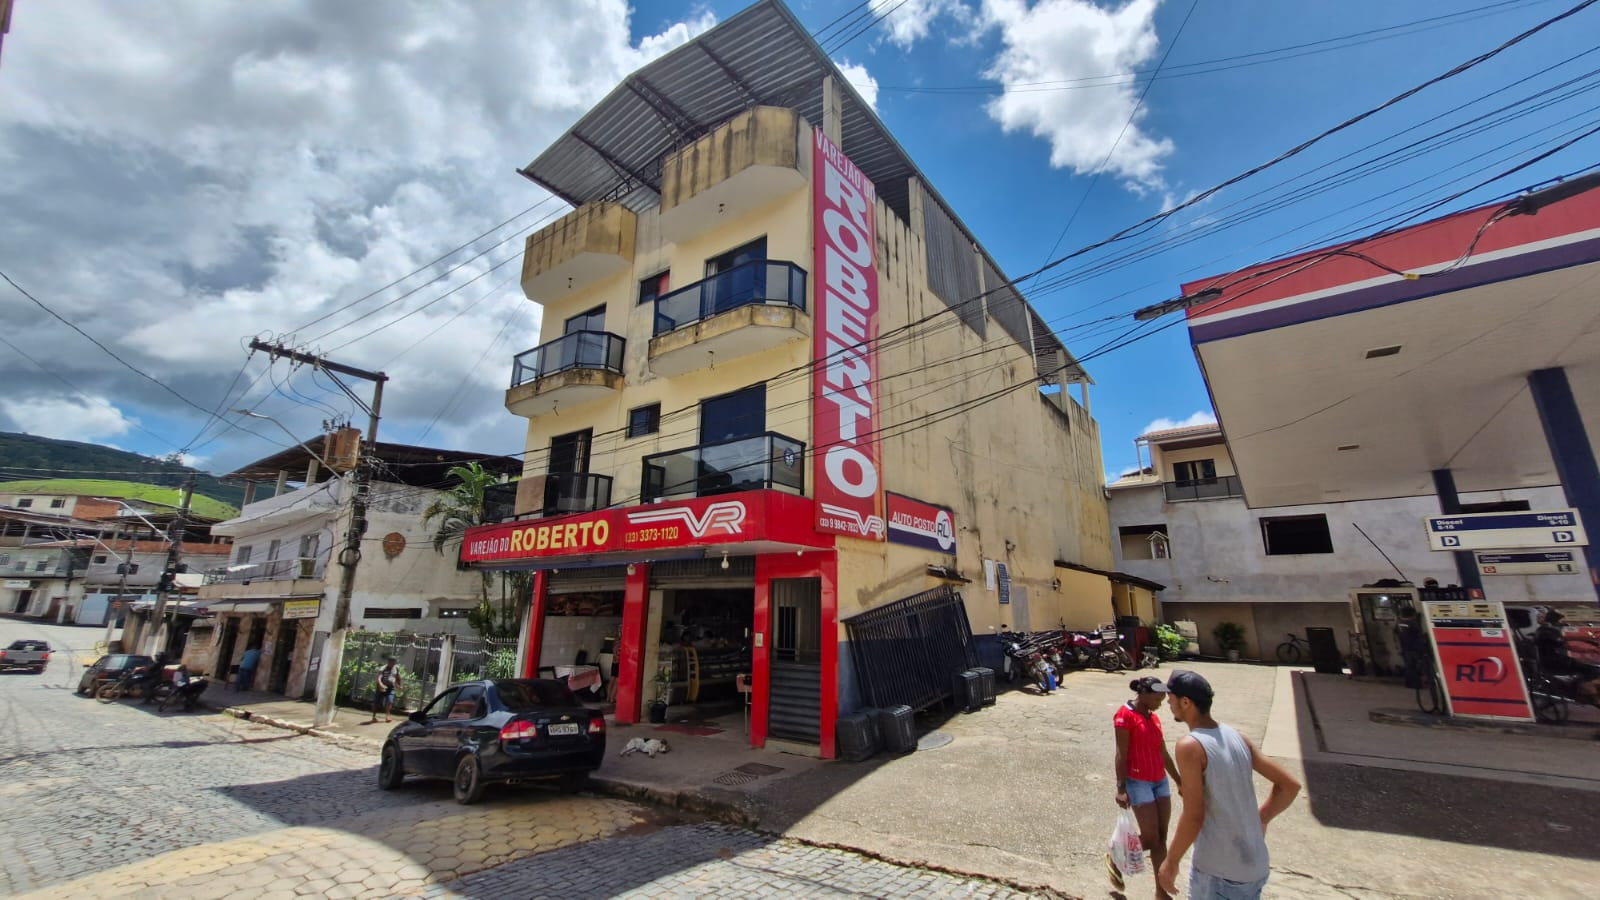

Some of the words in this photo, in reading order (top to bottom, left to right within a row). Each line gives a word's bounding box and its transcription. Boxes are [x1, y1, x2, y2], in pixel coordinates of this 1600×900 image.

[821, 159, 878, 498] ROBERTO
[892, 511, 913, 526] AUTO
[914, 517, 936, 532] POSTO
[510, 519, 609, 552] ROBERTO
[639, 526, 679, 542] 3373-1120
[1444, 536, 1457, 546] D
[1557, 532, 1572, 542] D
[500, 537, 509, 552] DO
